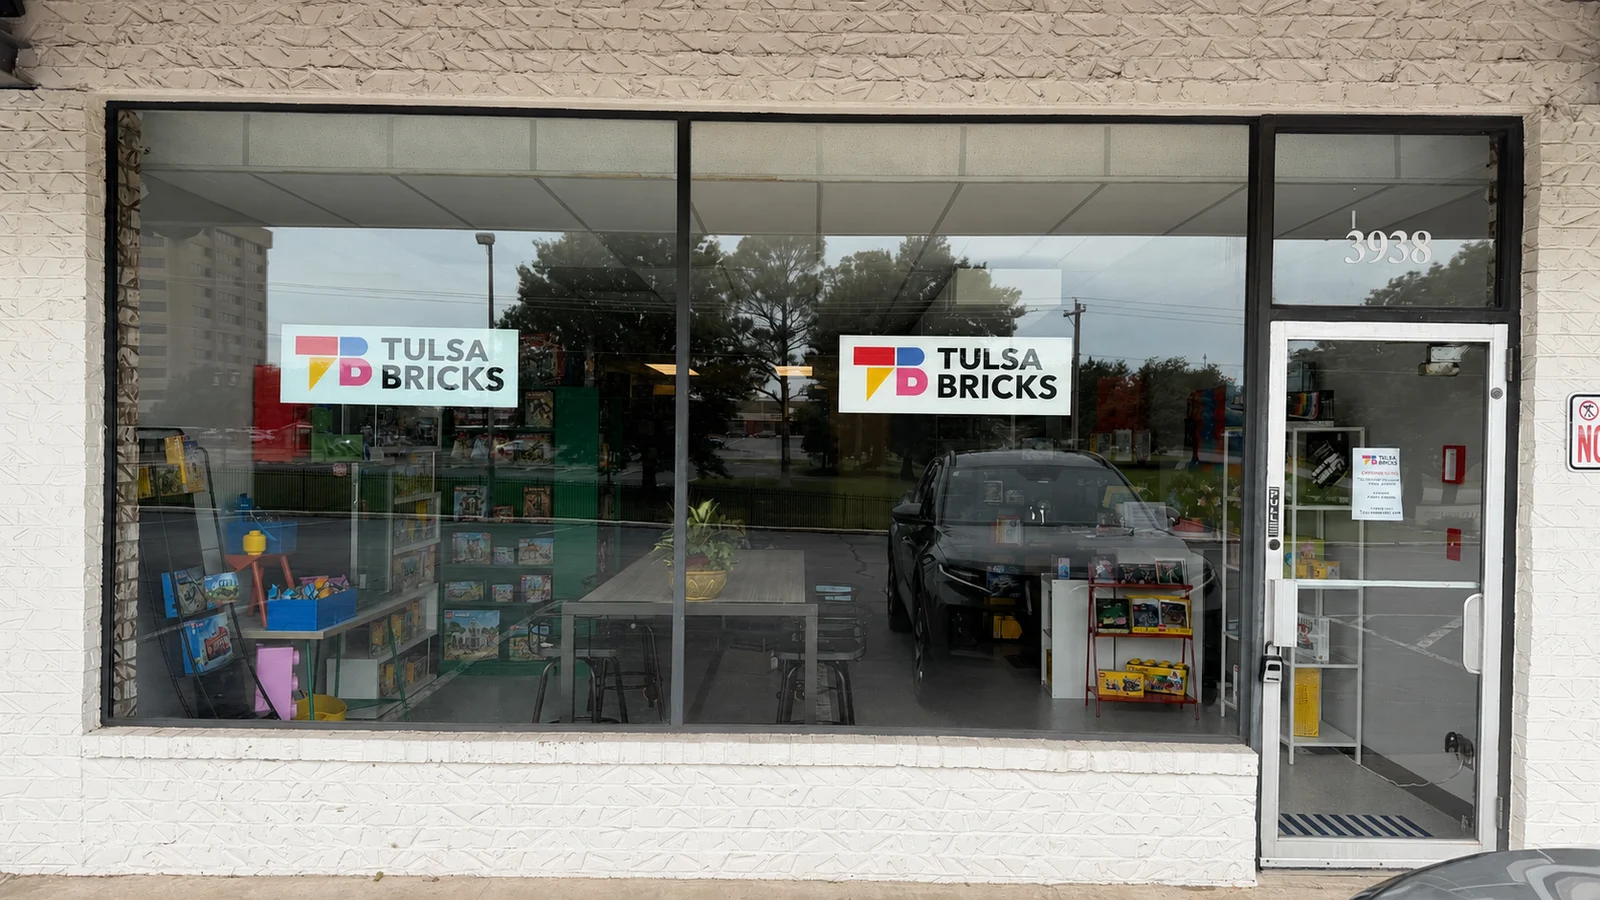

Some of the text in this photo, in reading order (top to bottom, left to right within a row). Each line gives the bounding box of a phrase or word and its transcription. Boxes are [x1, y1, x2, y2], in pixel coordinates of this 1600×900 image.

[1344, 230, 1432, 264] 3938
[381, 337, 489, 362] TULSA
[937, 347, 1043, 371] TULSA
[381, 364, 505, 392] BRICKS
[937, 374, 1058, 400] BRICKS
